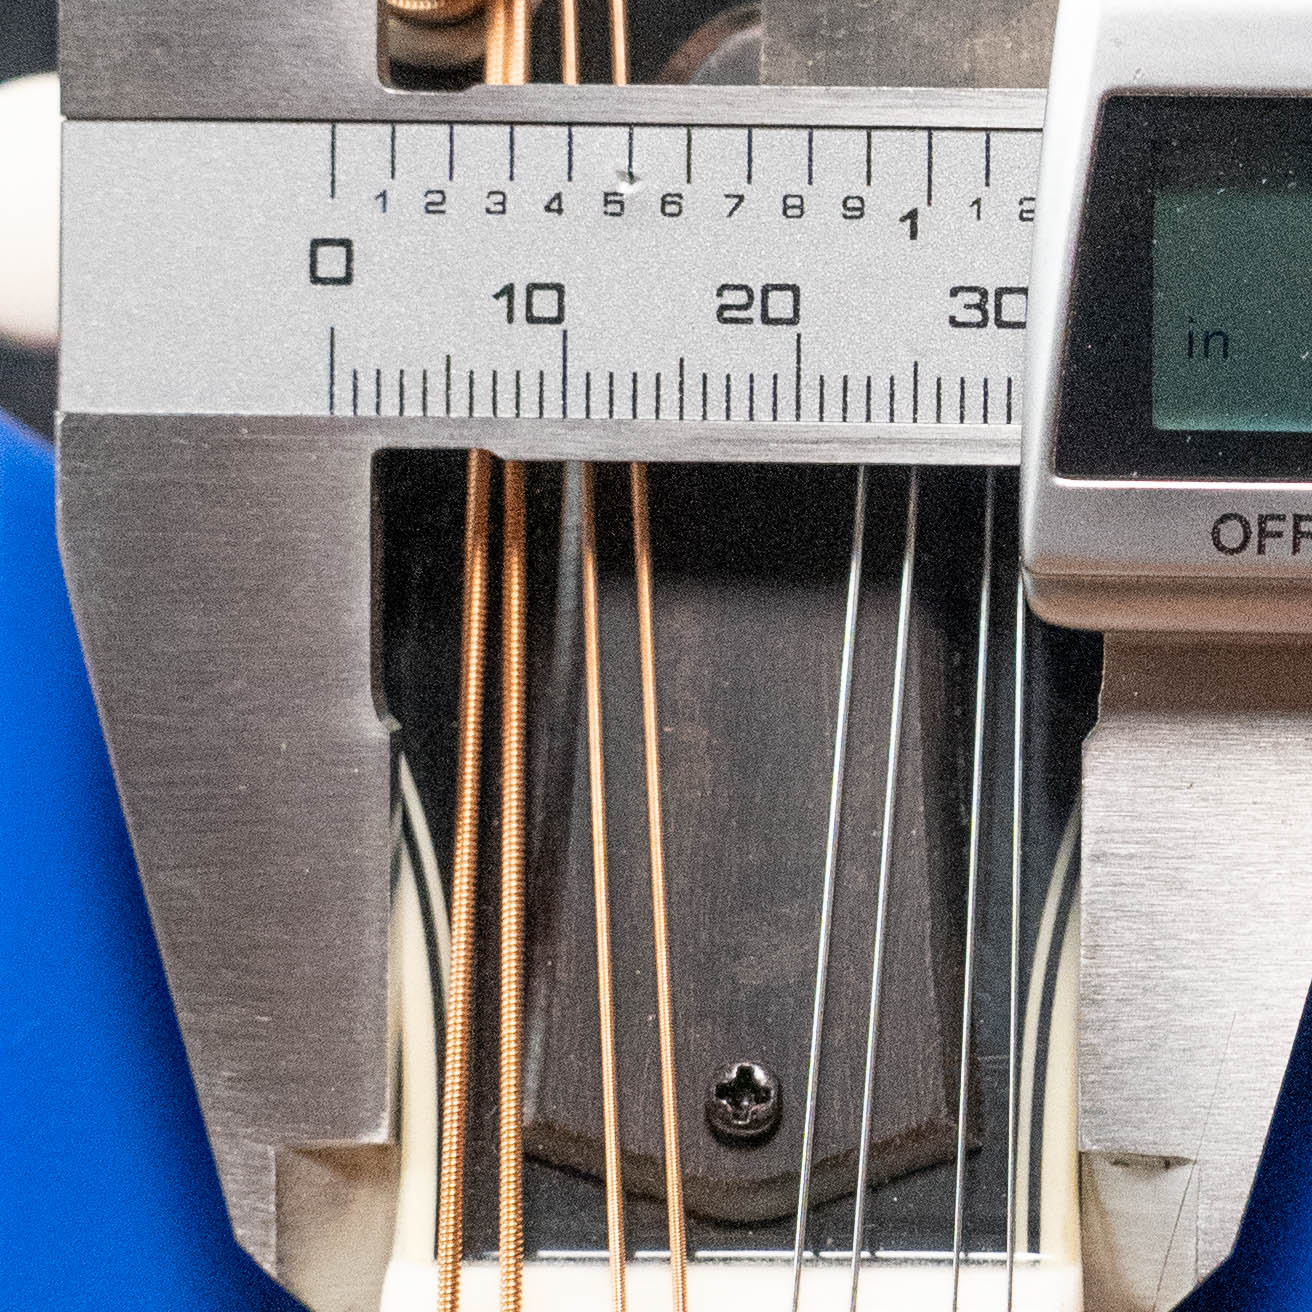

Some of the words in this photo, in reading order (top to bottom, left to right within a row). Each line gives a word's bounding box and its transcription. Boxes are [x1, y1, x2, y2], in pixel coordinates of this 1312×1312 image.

[375, 189, 388, 213] 1
[423, 189, 447, 215] 2
[485, 190, 507, 216] 3
[543, 191, 564, 216] 4
[603, 190, 626, 218] 5
[660, 192, 684, 218] 6
[724, 193, 745, 218] 7
[781, 193, 805, 219] 8
[841, 195, 866, 221] 9
[898, 207, 919, 241] 1
[969, 197, 982, 221] 1
[308, 237, 355, 287] 0
[491, 281, 566, 327] 10
[715, 282, 801, 327] 20
[947, 285, 1029, 330] 30
[1186, 317, 1231, 360] in
